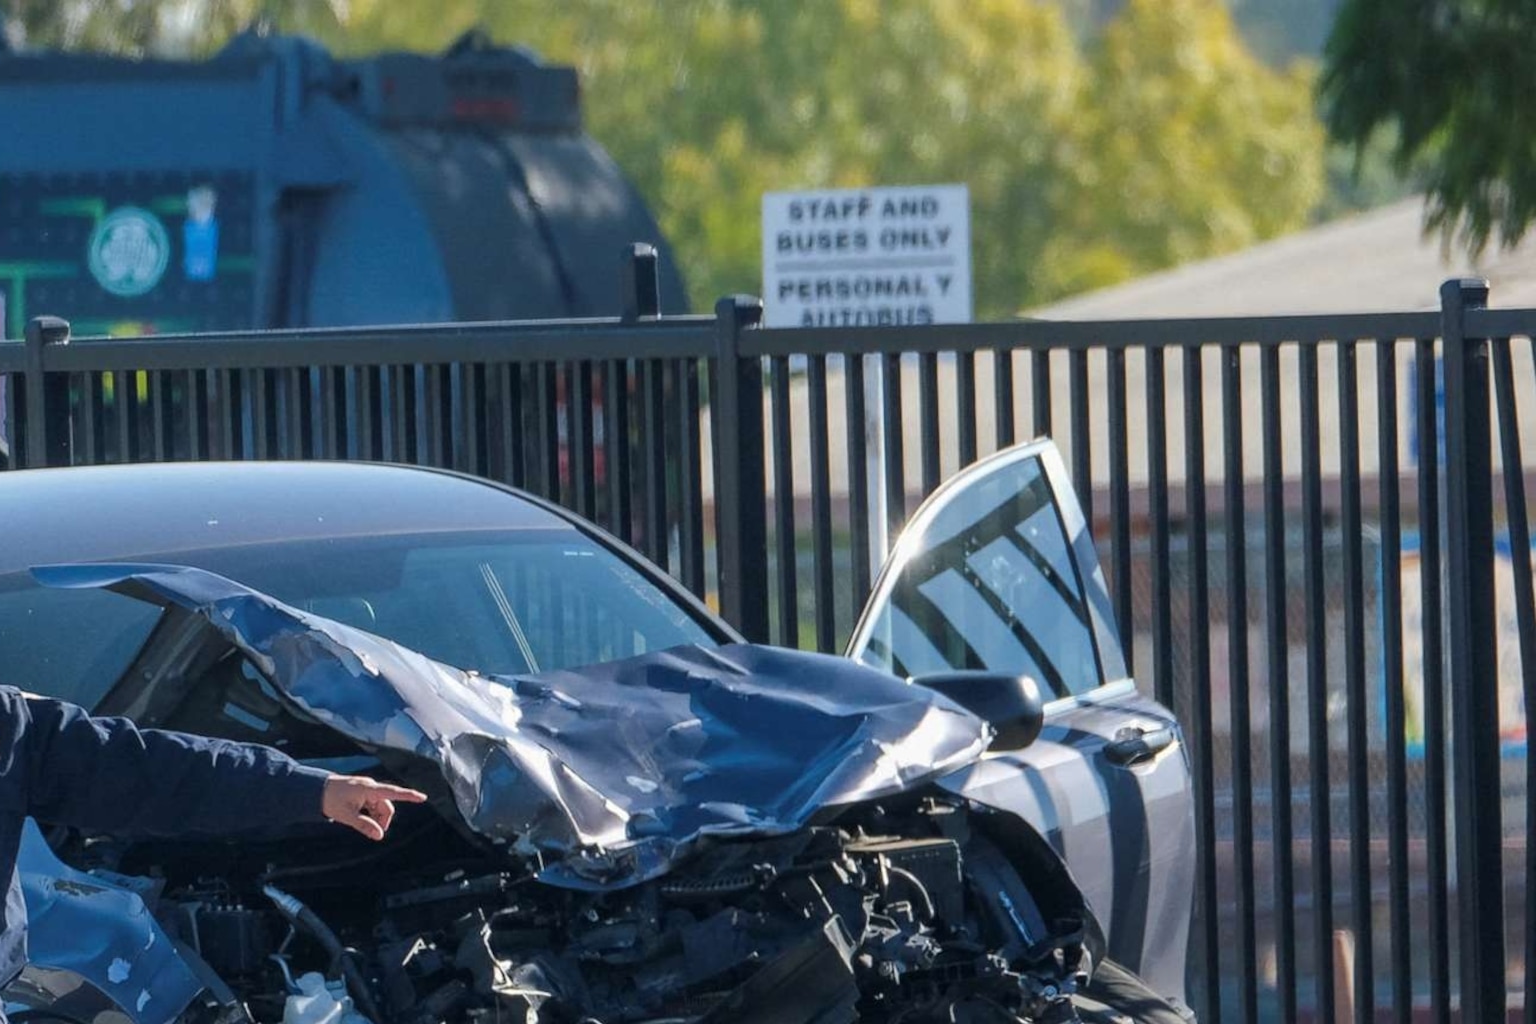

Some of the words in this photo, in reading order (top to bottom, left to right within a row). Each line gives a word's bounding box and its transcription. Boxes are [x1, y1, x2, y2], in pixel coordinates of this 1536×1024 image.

[789, 197, 872, 222] STAFF
[882, 194, 939, 218] AND
[777, 229, 868, 251] BUSES
[880, 226, 951, 249] ONLY
[779, 276, 927, 301] PERSONAL
[937, 273, 952, 296] Y
[802, 303, 934, 326] AUTOBUS
